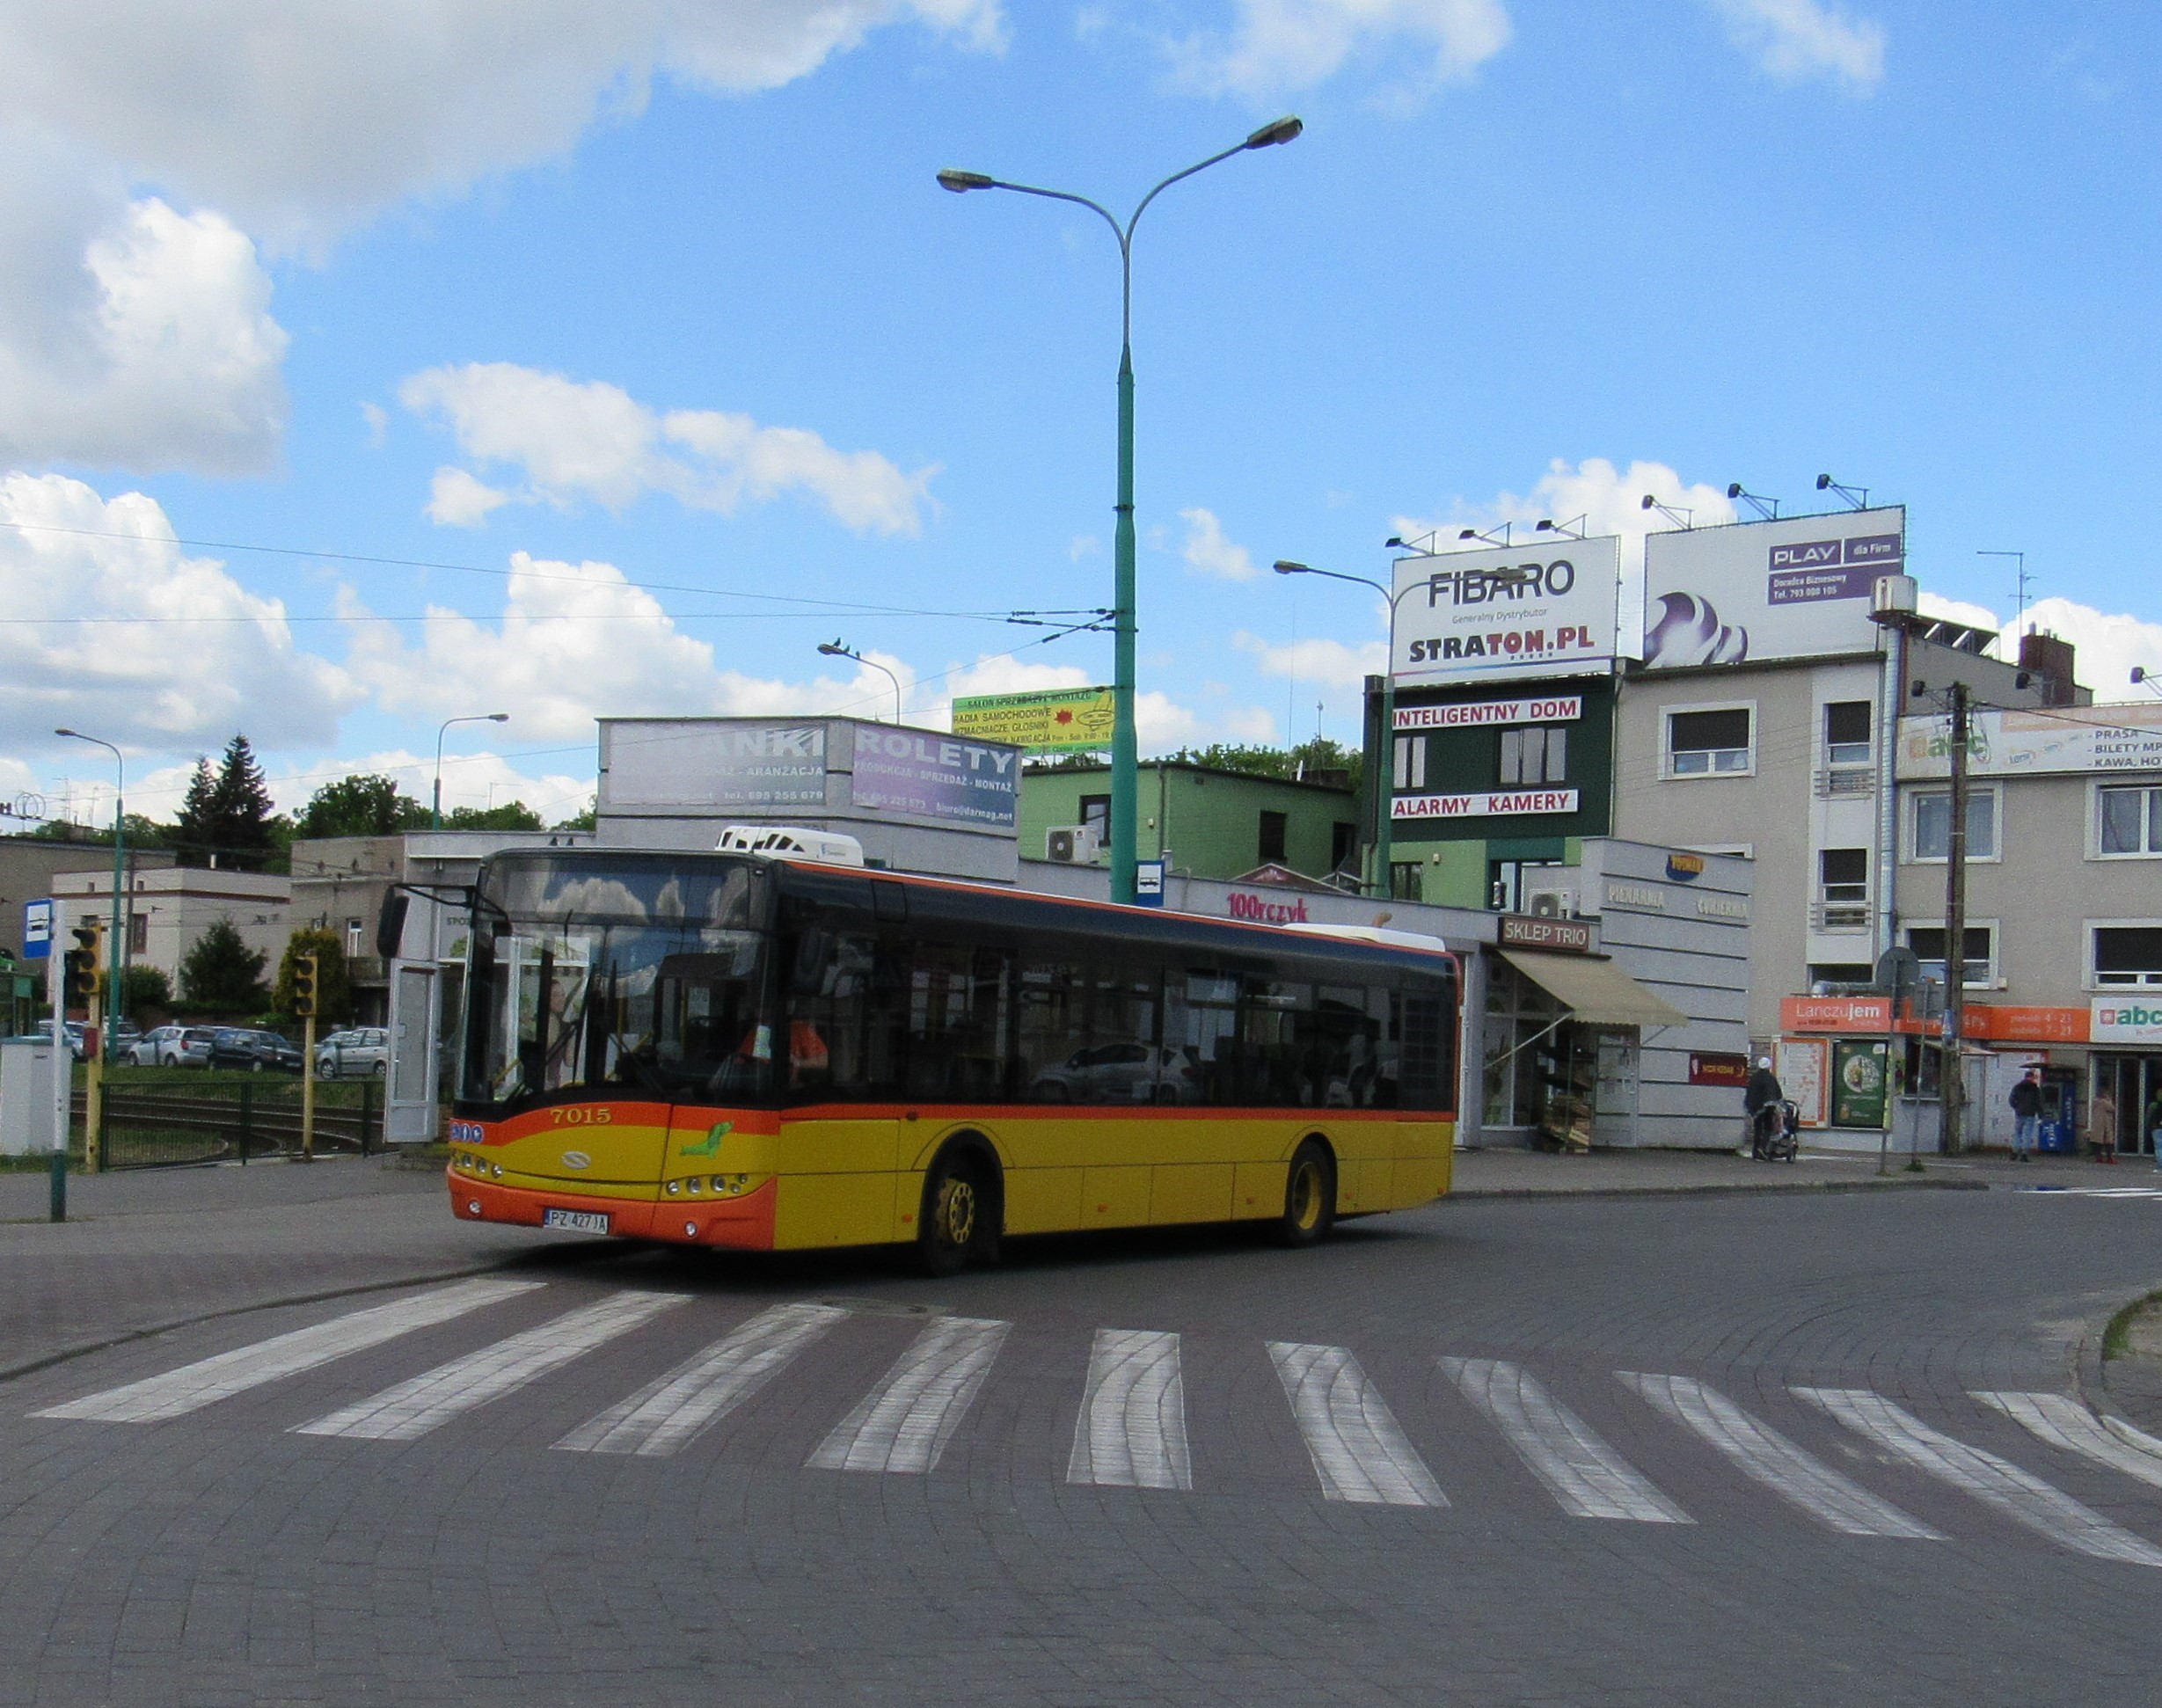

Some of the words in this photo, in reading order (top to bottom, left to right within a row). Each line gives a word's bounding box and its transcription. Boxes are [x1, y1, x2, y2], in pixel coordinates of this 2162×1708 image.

[1773, 544, 1837, 565] PLAY
[1853, 544, 1868, 555] dla
[1870, 543, 1891, 554] Firm
[1428, 559, 1574, 608] FIBARO
[1451, 612, 1494, 625] Generalny
[1496, 608, 1548, 621] Dystrybutor
[1409, 625, 1596, 662] STRATON.PL
[982, 708, 1052, 721] SAMOCHODOWE
[1393, 703, 1520, 727] INTELIGENTNY
[1530, 700, 1577, 718] DOM
[2094, 729, 2139, 740] PRASA
[854, 728, 1014, 774] ROLETY
[2094, 743, 2139, 755] BILETY
[920, 770, 968, 786] SPRZEDAŻ
[975, 778, 1012, 792] MONTAŻ
[1393, 796, 1471, 816] ALARMY
[1487, 792, 1569, 813] KAMERY
[1505, 922, 1551, 941] SKLEP
[1555, 927, 1586, 945] TRIO
[550, 1108, 612, 1124] 7015
[551, 1211, 567, 1227] PZ
